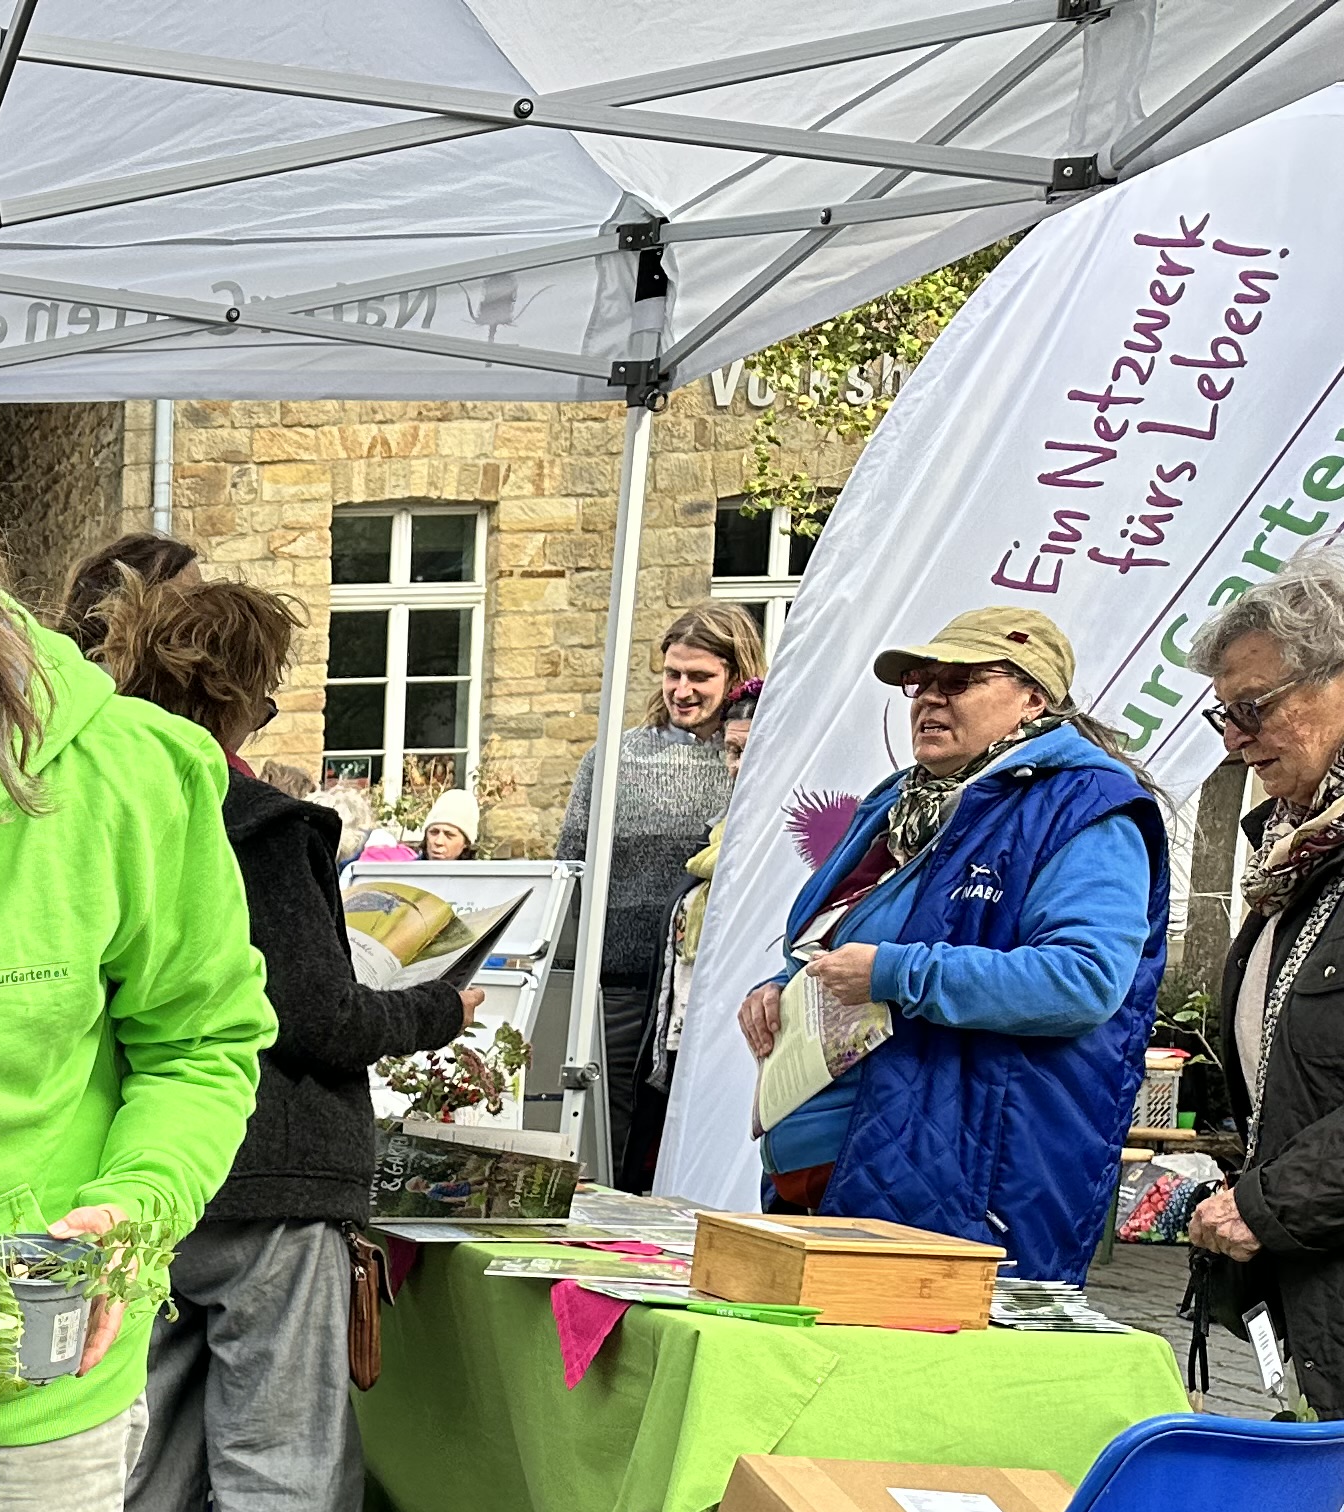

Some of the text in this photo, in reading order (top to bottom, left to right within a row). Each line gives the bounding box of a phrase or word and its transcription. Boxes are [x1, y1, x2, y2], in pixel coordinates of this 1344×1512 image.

[991, 212, 1211, 594] Ein Netzwerk
[1087, 238, 1290, 575] fürs Leben!
[961, 884, 1004, 903] NABU
